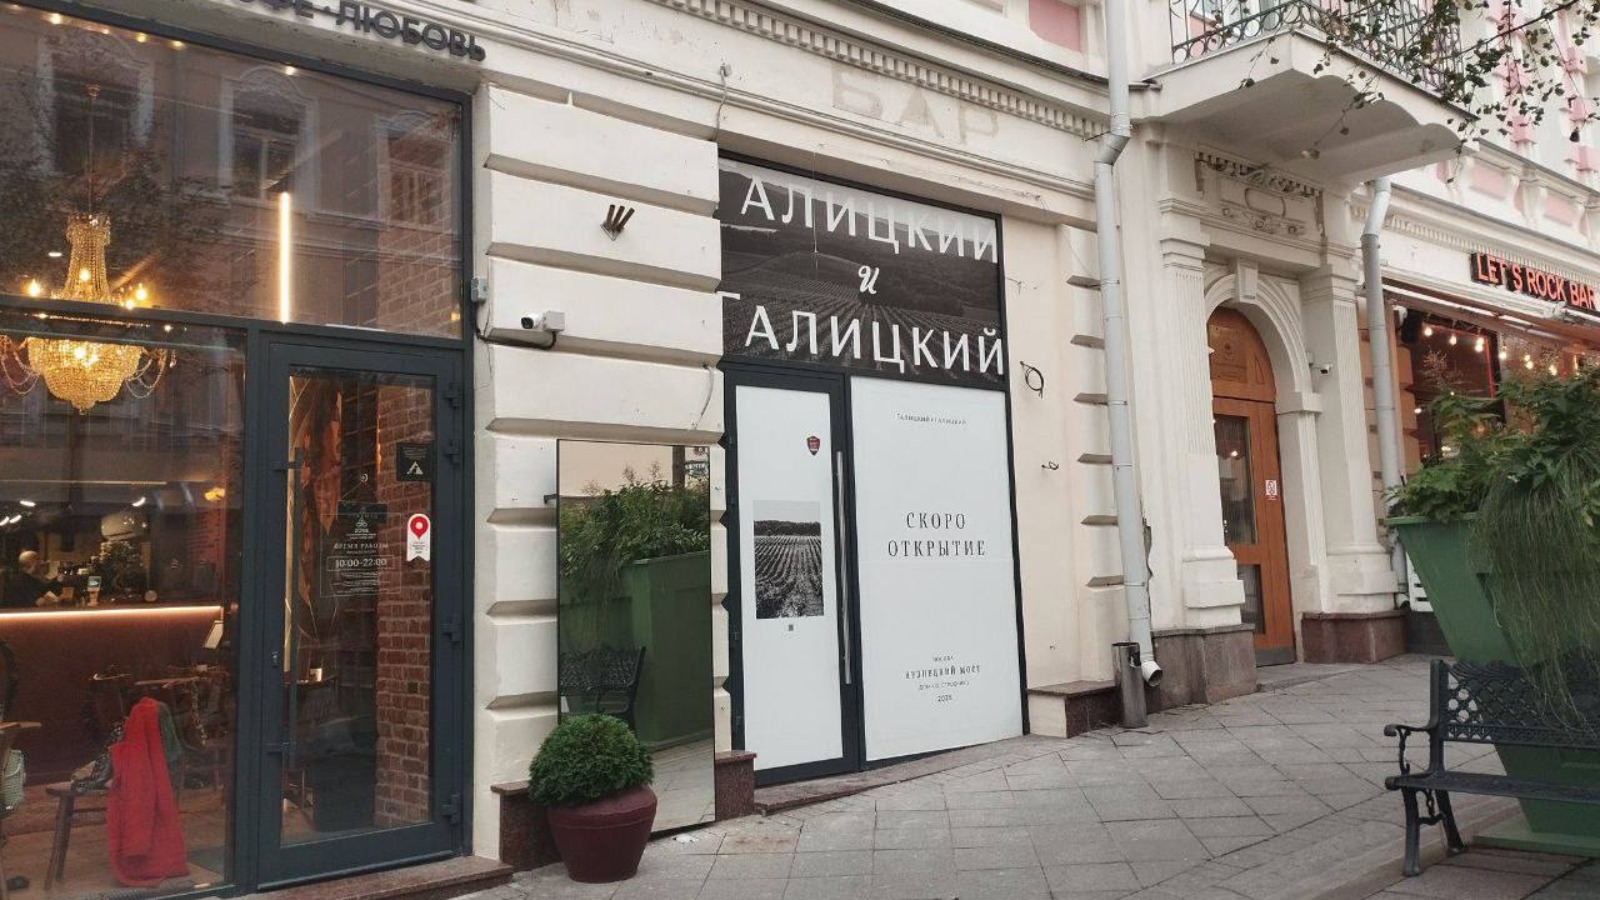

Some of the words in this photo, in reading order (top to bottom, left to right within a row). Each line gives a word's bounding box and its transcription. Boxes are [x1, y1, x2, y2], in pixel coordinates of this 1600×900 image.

[336, 2, 486, 62] ЛЮБОВЬ
[832, 62, 999, 145] БАР
[857, 264, 880, 295] и
[1525, 266, 1567, 301] ROCK
[1569, 281, 1596, 310] BAR
[906, 511, 966, 530] СКОРО
[887, 539, 986, 557] ОТКРЫТИЕ
